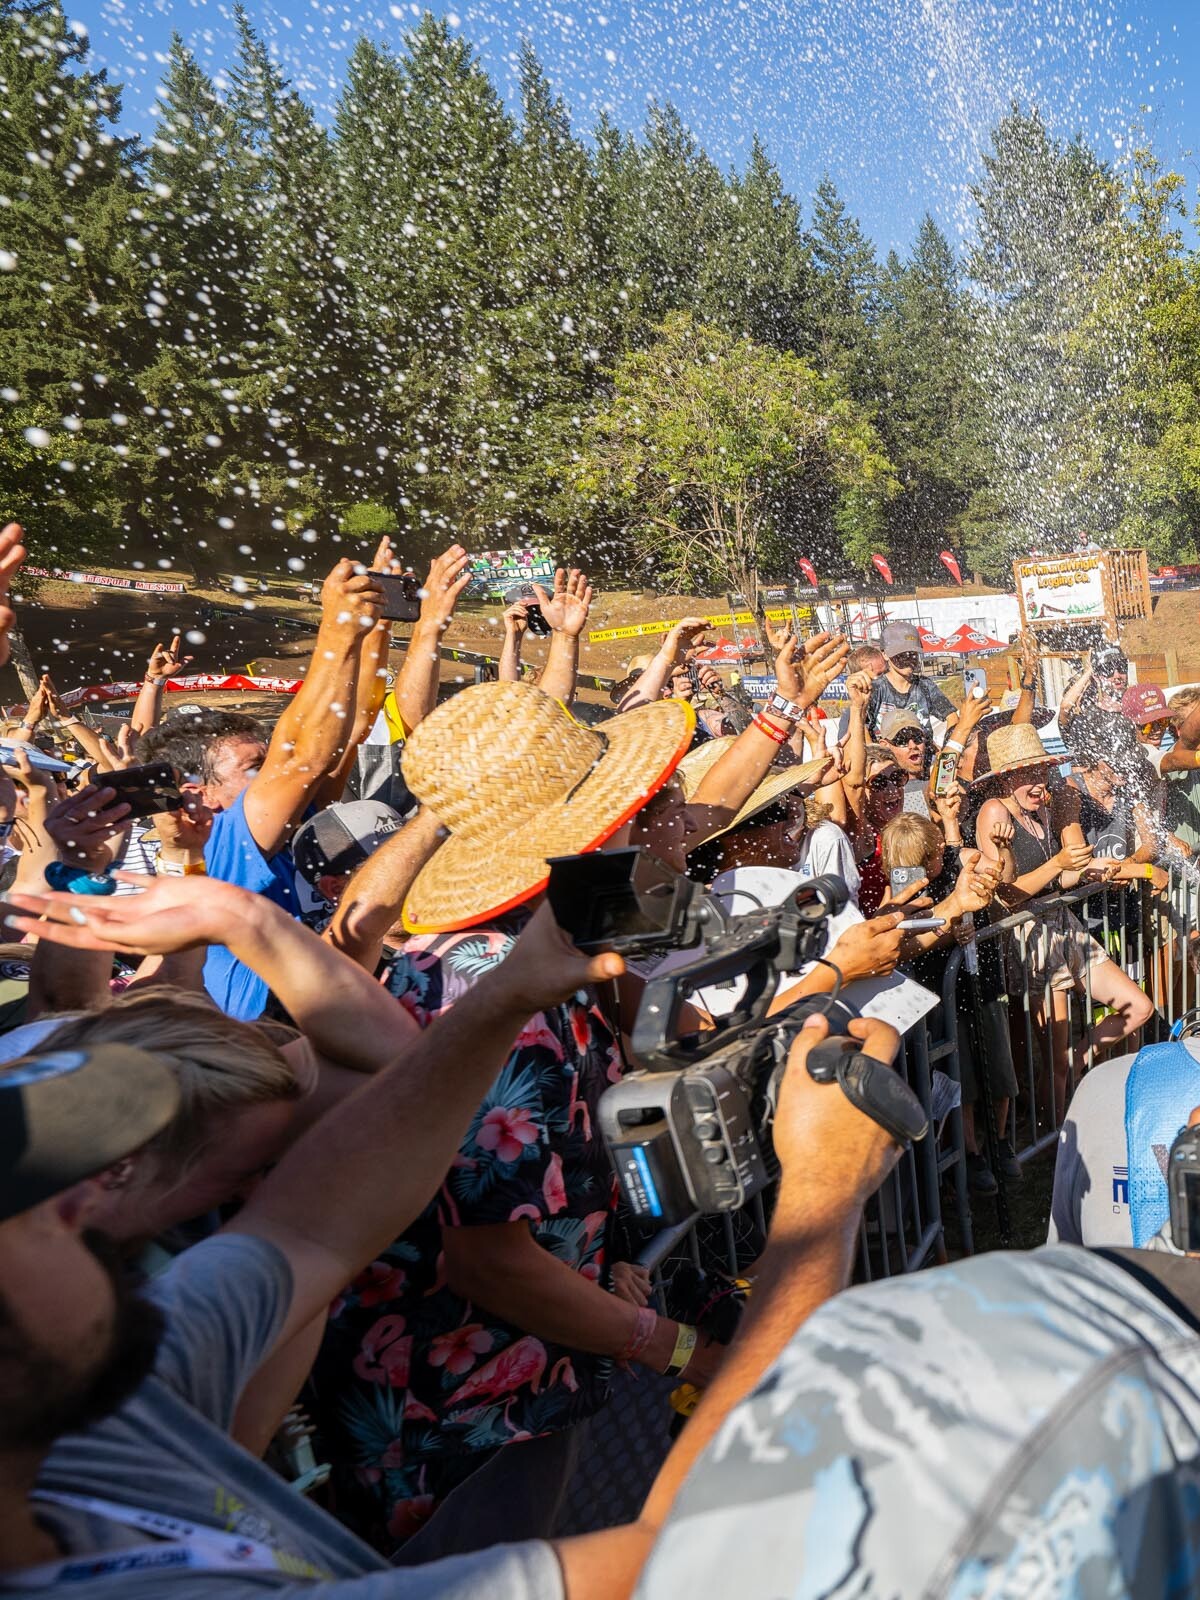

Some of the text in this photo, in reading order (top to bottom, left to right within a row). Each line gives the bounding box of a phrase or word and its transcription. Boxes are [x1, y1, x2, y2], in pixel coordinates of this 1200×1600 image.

[461, 562, 552, 580] shougal
[168, 675, 298, 689] FLY FLY
